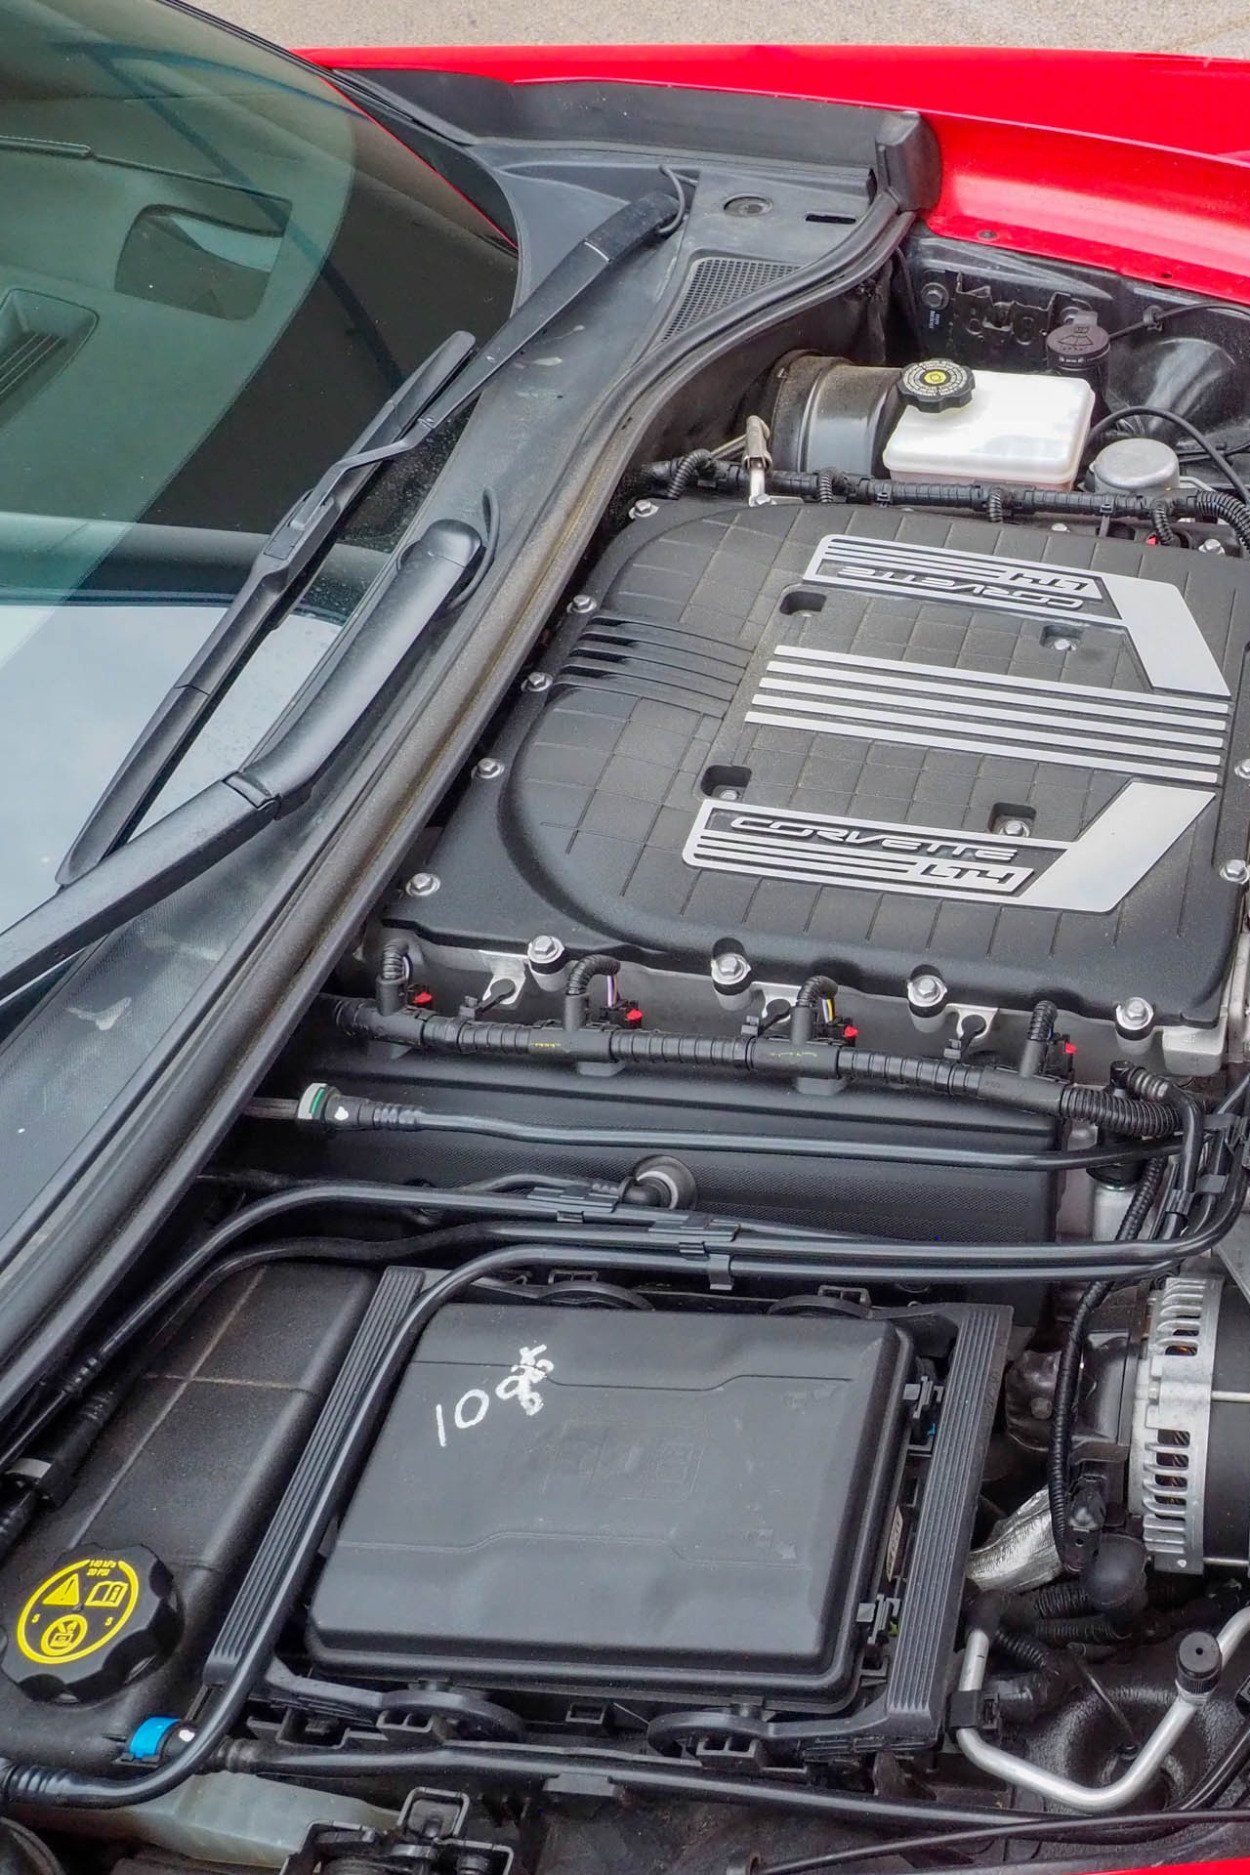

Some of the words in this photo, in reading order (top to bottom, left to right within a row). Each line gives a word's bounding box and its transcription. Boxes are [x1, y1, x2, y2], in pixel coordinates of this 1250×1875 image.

[837, 566, 1084, 611] CORVETTE
[1008, 572, 1089, 591] LT4
[730, 816, 1018, 862] CORVETTE
[919, 863, 1015, 885] LT4
